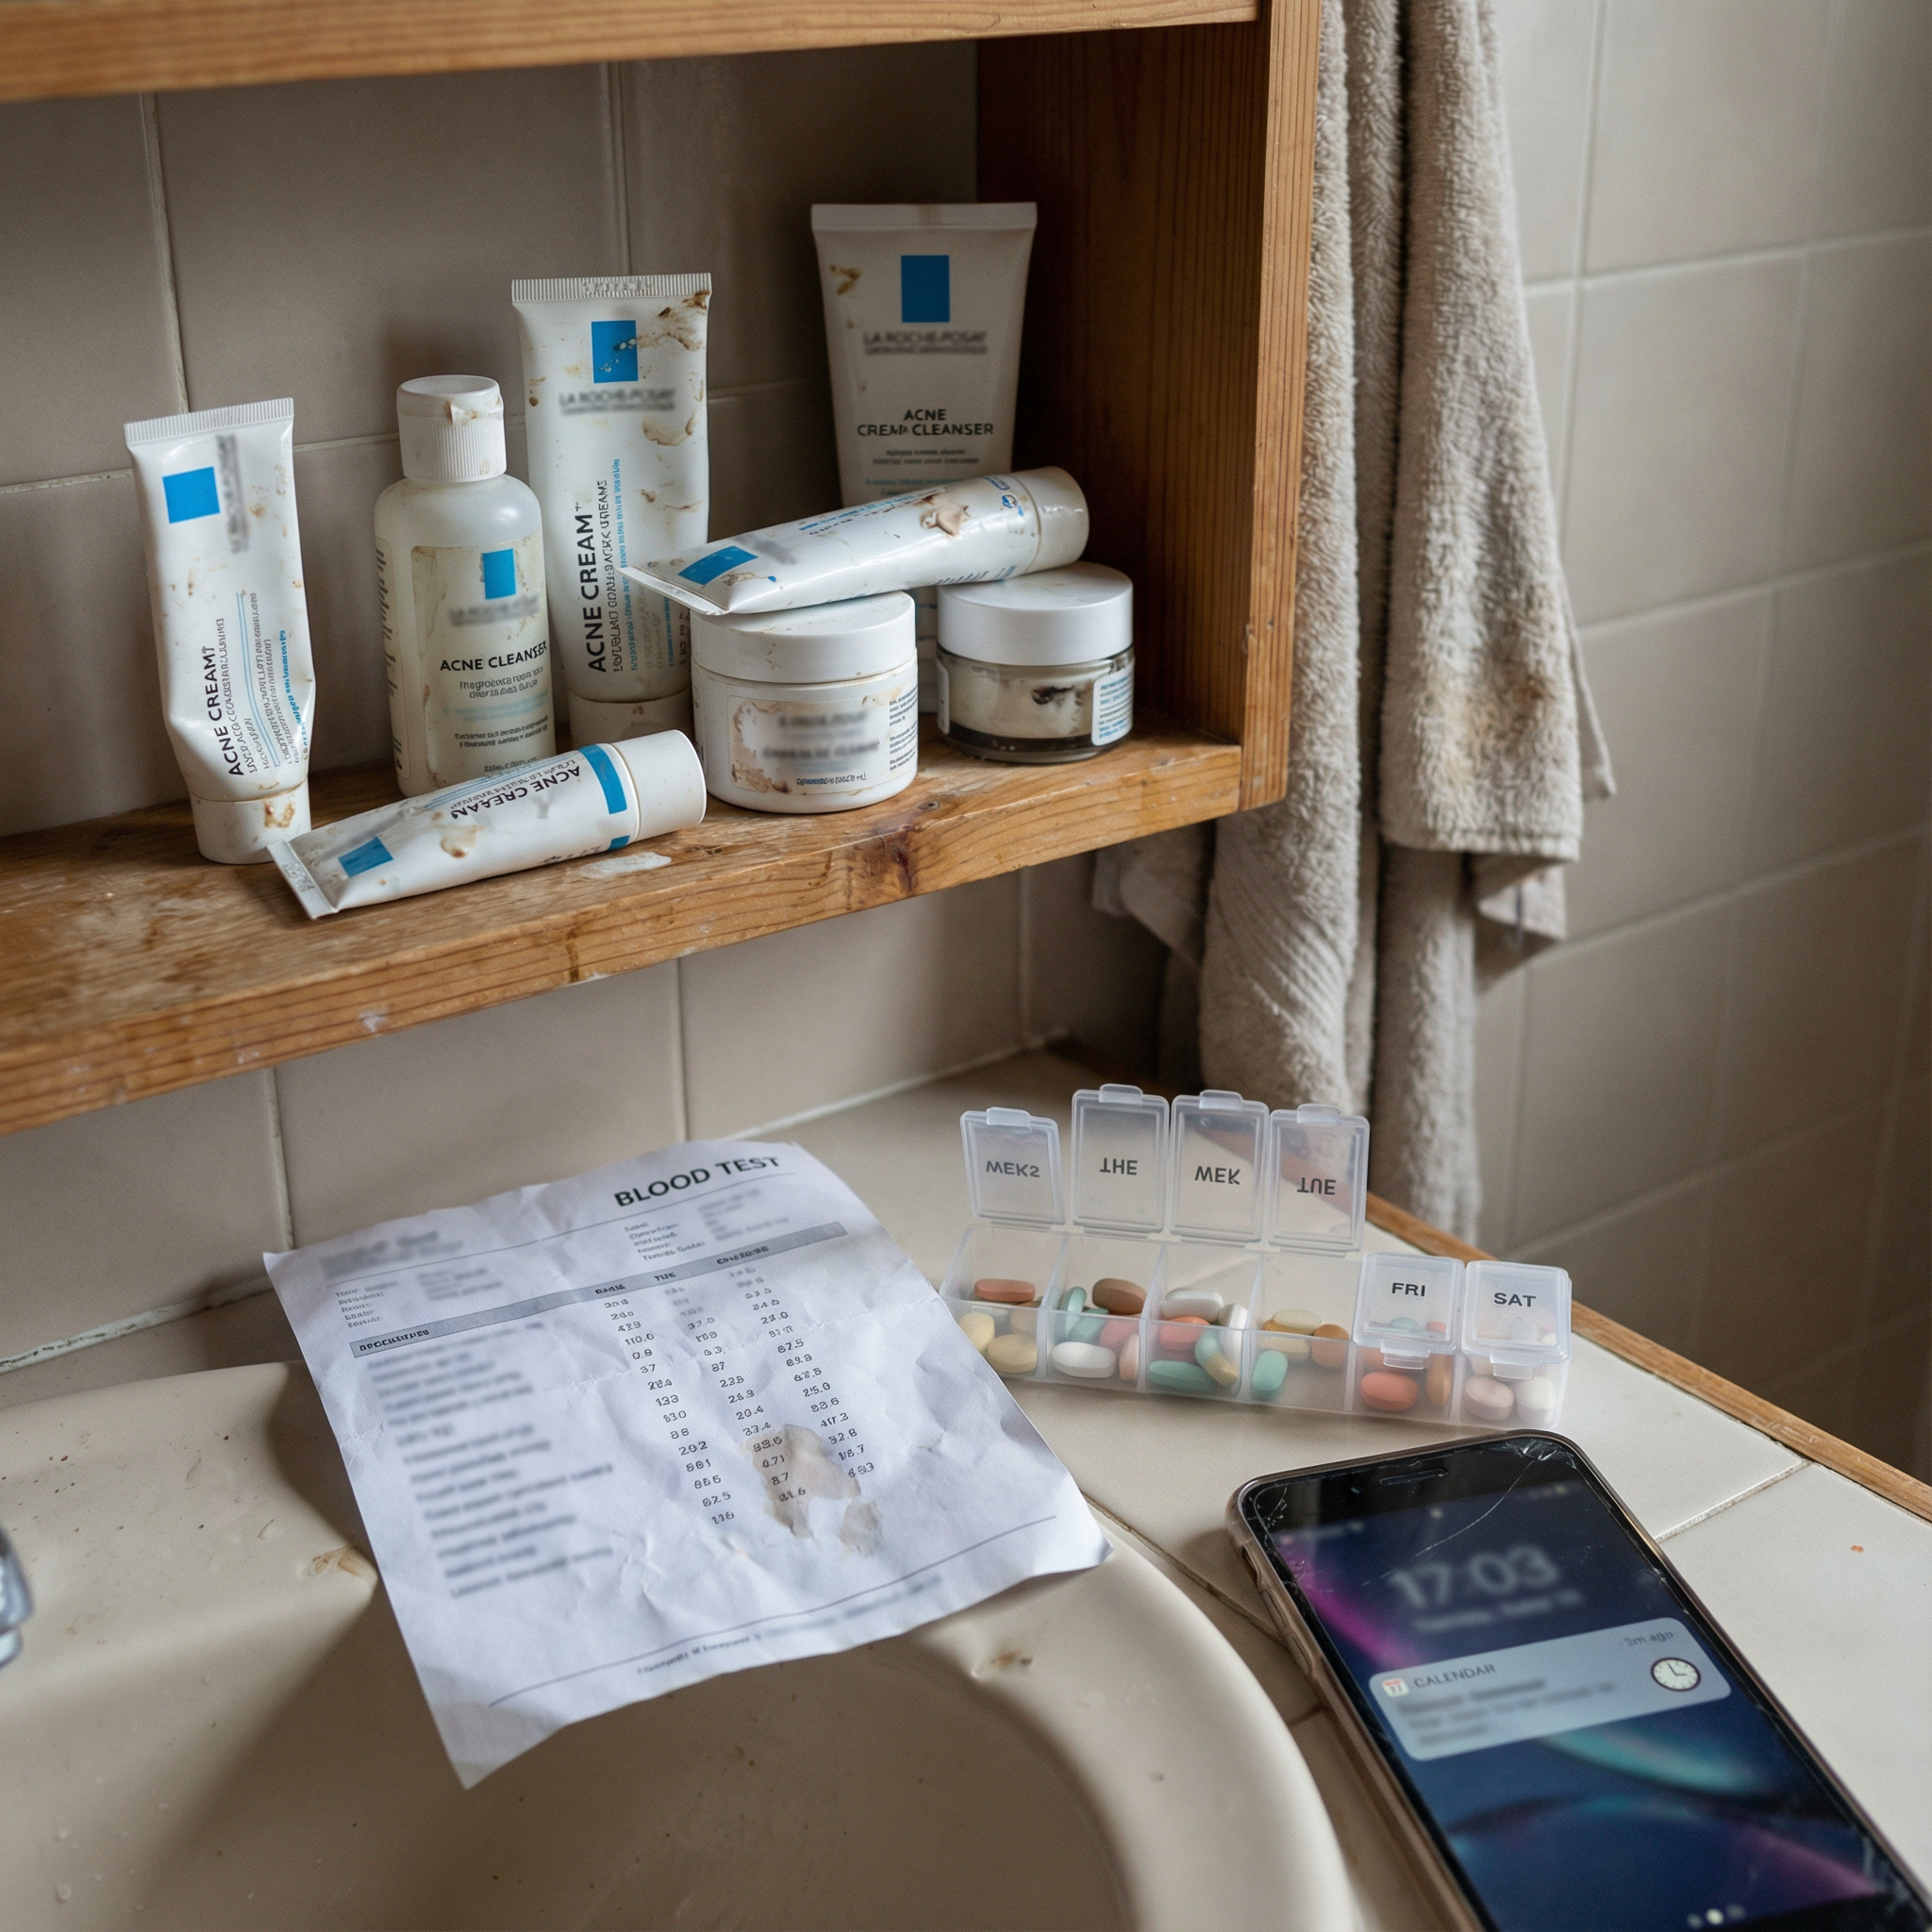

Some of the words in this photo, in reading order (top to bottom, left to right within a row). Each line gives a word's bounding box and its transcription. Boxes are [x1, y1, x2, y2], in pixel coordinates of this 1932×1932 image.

[904, 408, 946, 421] ACNE
[912, 424, 993, 436] CLEANSER
[583, 607, 607, 673] ACNE
[441, 658, 483, 671] ACNE
[214, 725, 244, 775] ACNE
[530, 765, 580, 791] ACNE
[613, 1169, 710, 1208] BLOOD
[714, 1157, 779, 1175] TEST
[1391, 1282, 1426, 1297] FRI
[1493, 1291, 1537, 1307] SAT
[1413, 1663, 1498, 1688] CALENDAR
